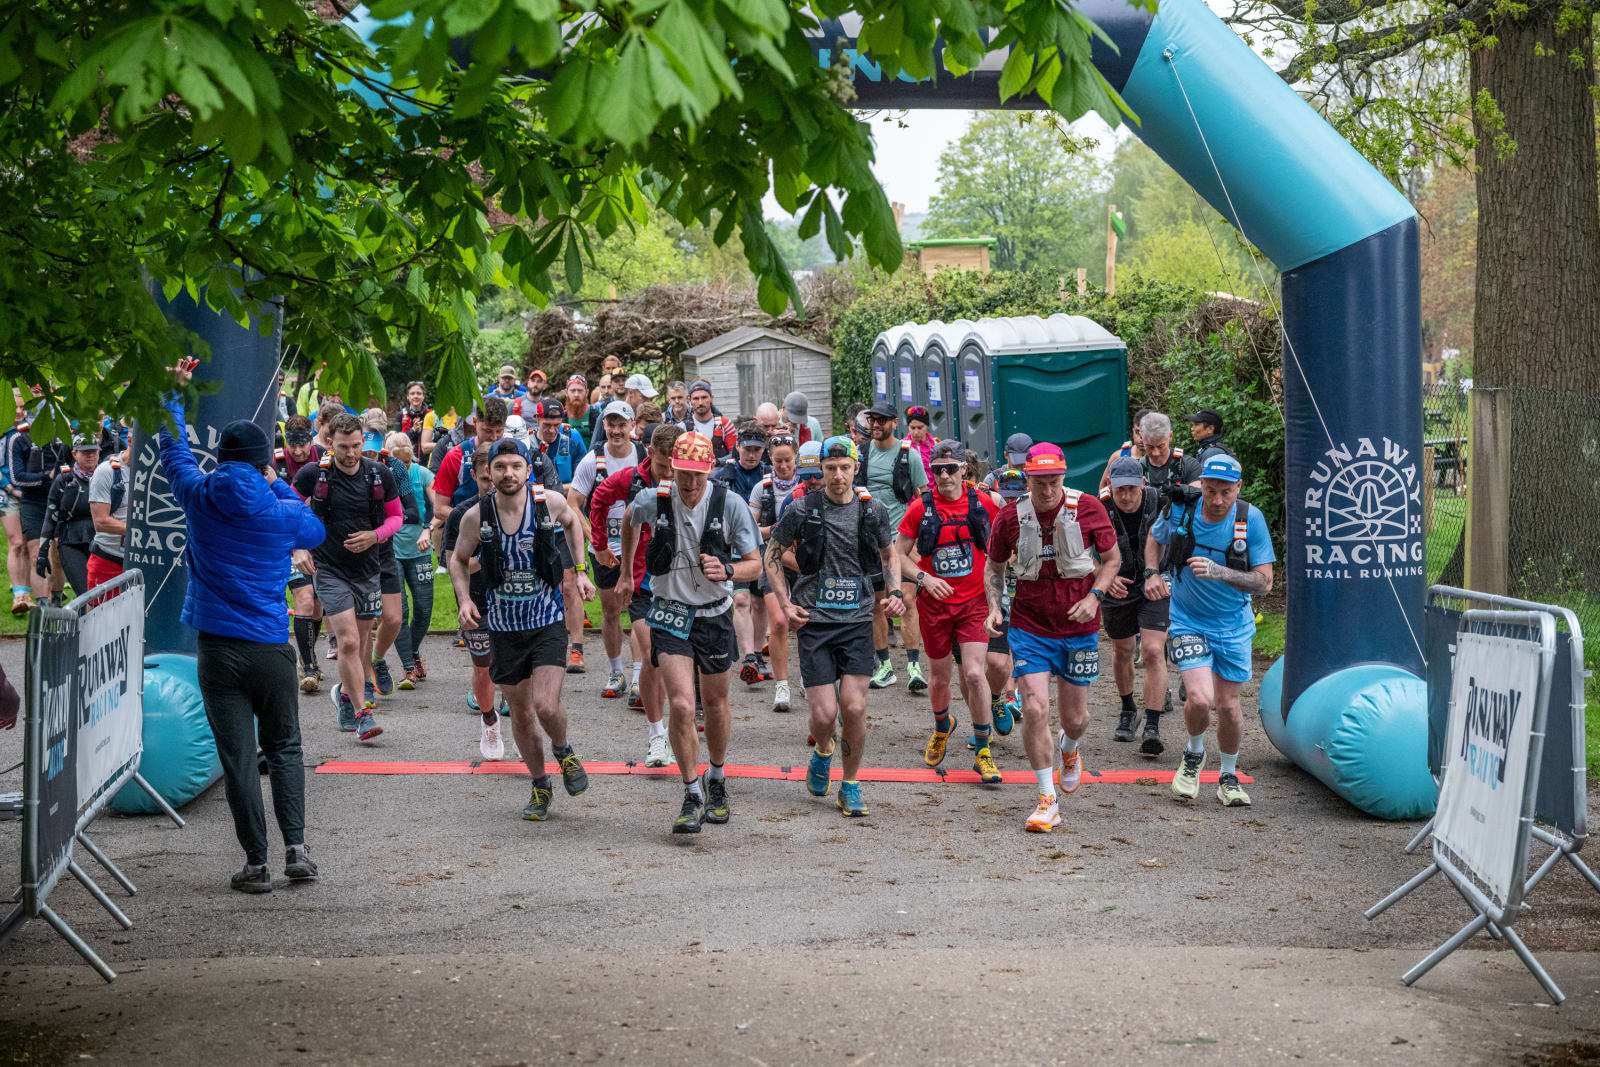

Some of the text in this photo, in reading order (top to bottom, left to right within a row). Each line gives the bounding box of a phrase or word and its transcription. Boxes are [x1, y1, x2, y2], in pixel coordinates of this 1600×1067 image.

[1305, 437, 1422, 508] RUNAWAY
[130, 527, 187, 553] RAC
[129, 553, 165, 567] TRAIL
[1305, 542, 1422, 565] RACING
[1305, 566, 1422, 579] TRAIL RUNNING
[503, 582, 534, 594] 035
[825, 589, 855, 601] 095
[654, 609, 685, 628] 096
[1175, 644, 1204, 659] 039
[1074, 662, 1098, 674] 038
[78, 625, 130, 731] RUNAWAY
[90, 683, 120, 729] RACING
